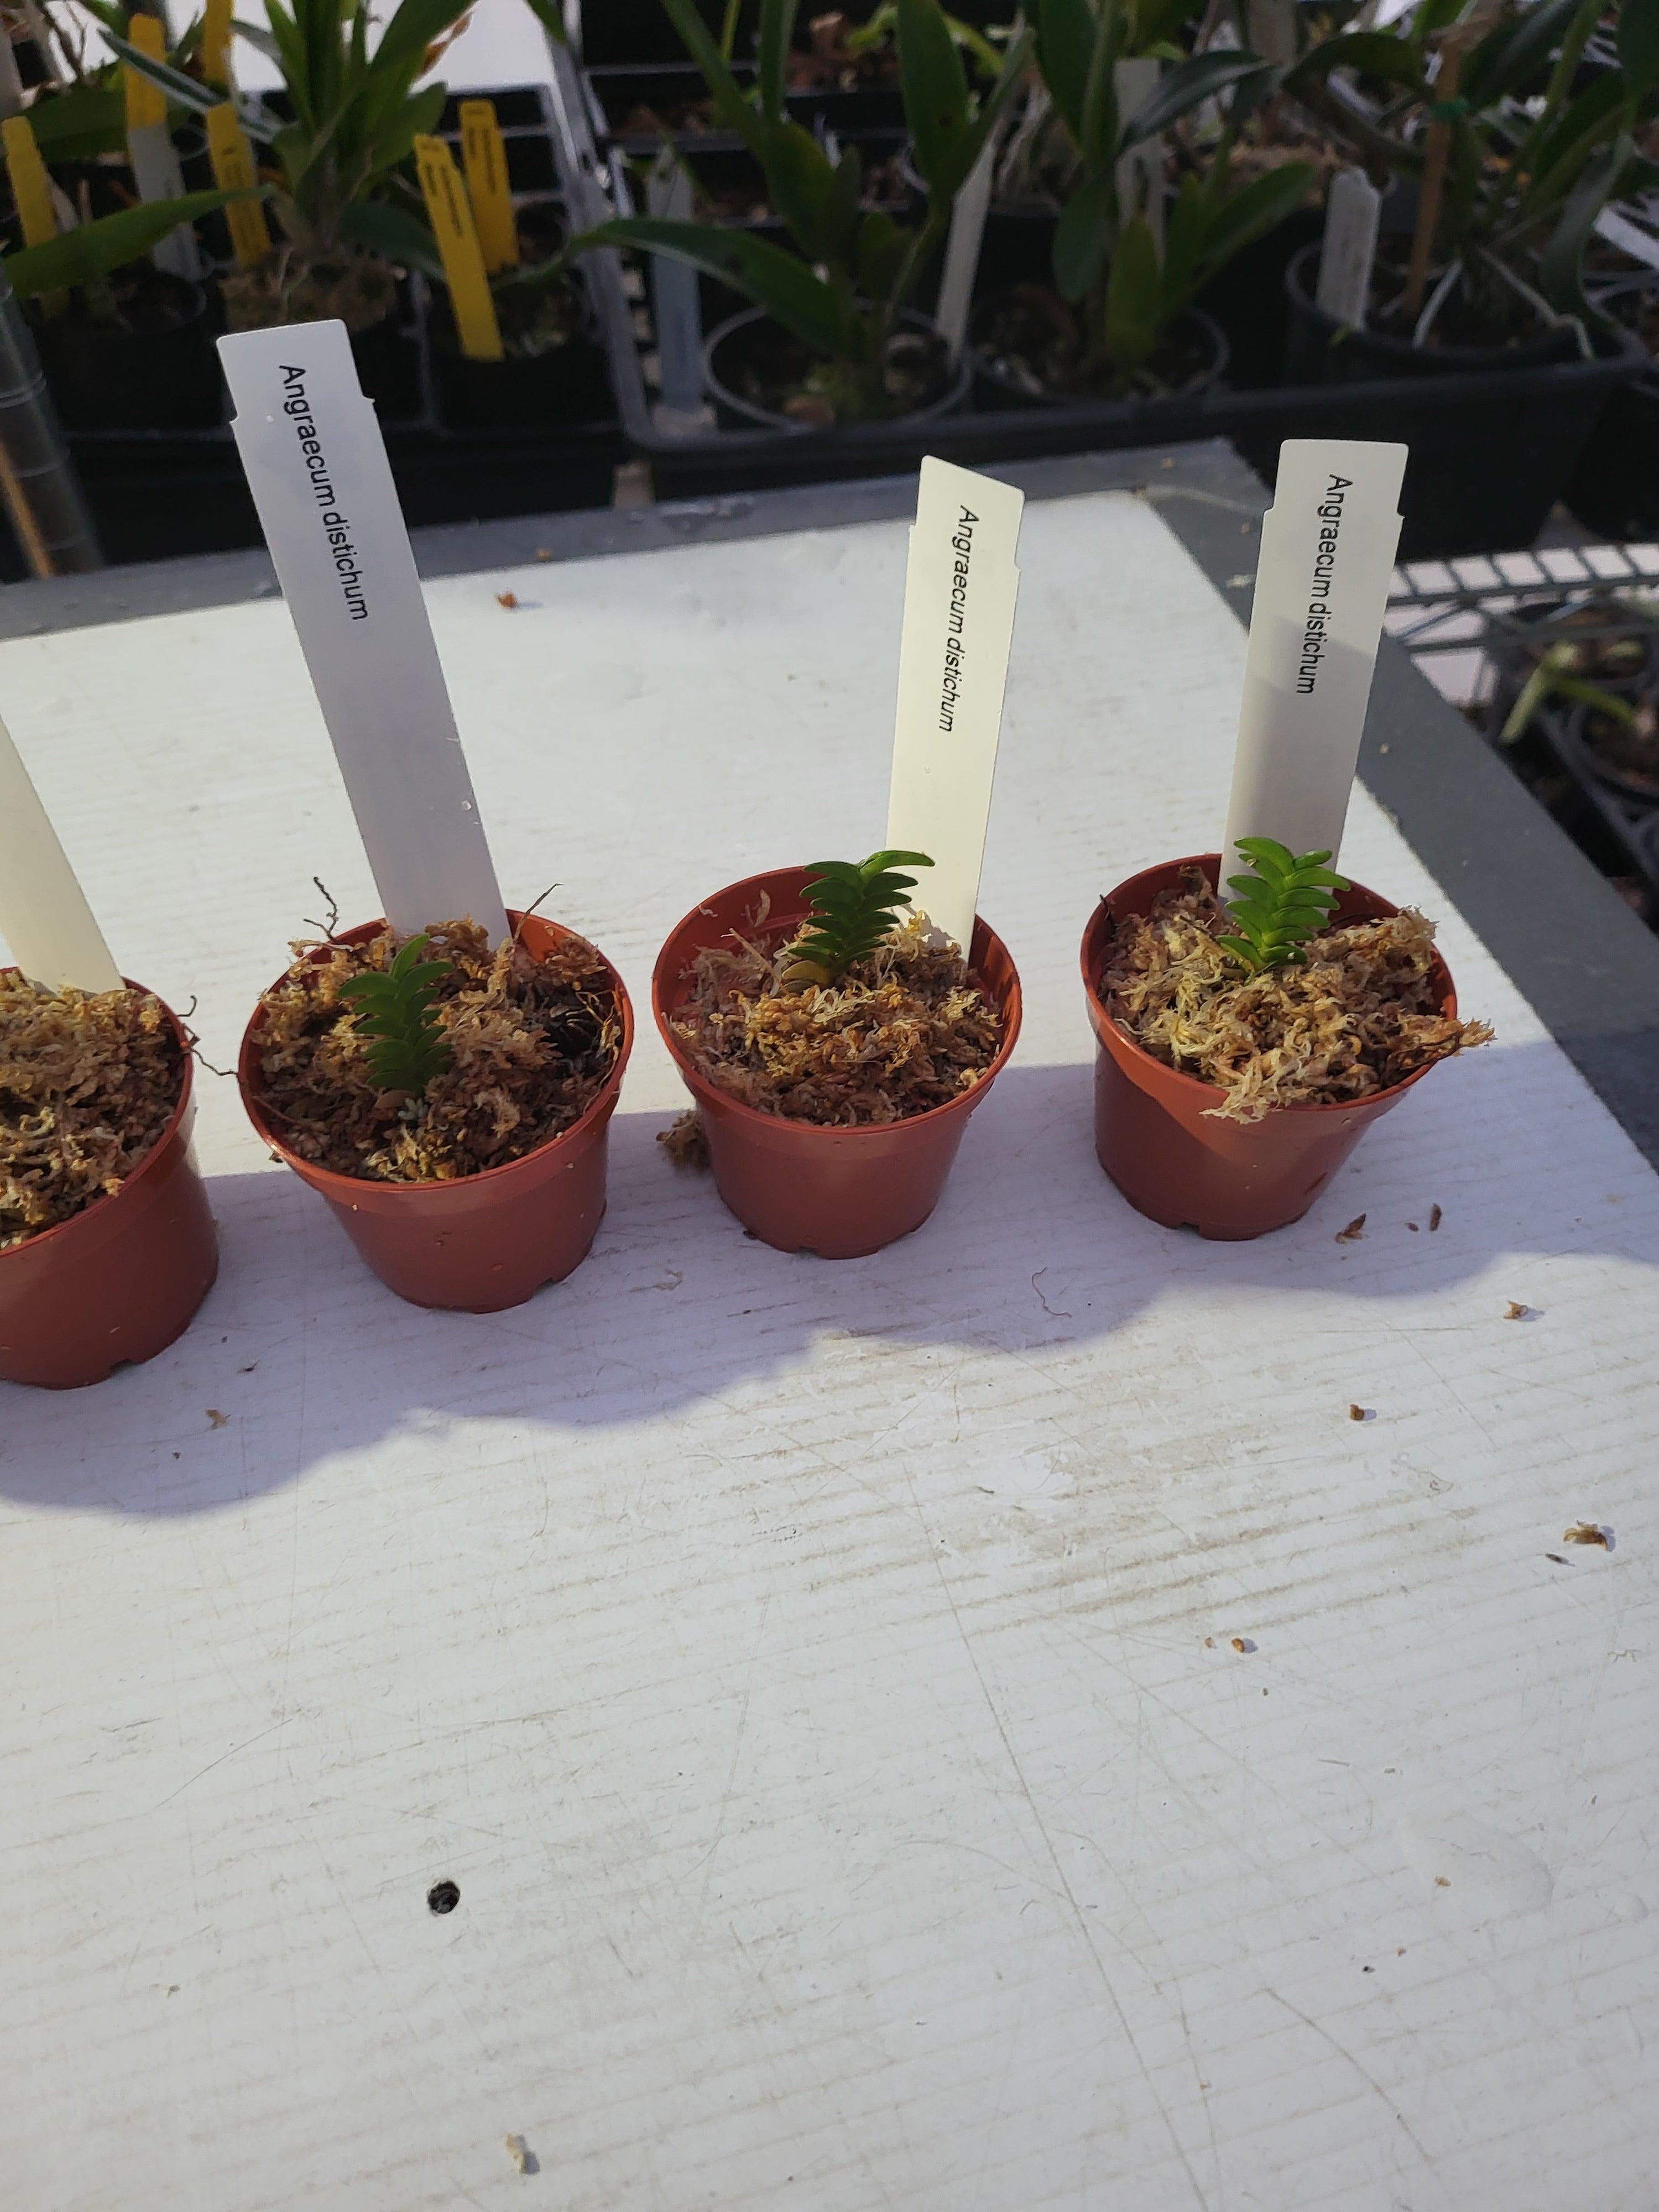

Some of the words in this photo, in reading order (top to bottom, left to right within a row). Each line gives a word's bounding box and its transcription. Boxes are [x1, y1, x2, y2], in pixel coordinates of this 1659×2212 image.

[279, 365, 336, 507] Angraecum
[323, 512, 369, 620] distichum
[1311, 474, 1353, 598] Angraecum
[948, 504, 979, 634] Angraecum
[939, 637, 966, 733] distichum
[1296, 602, 1332, 695] distichum
